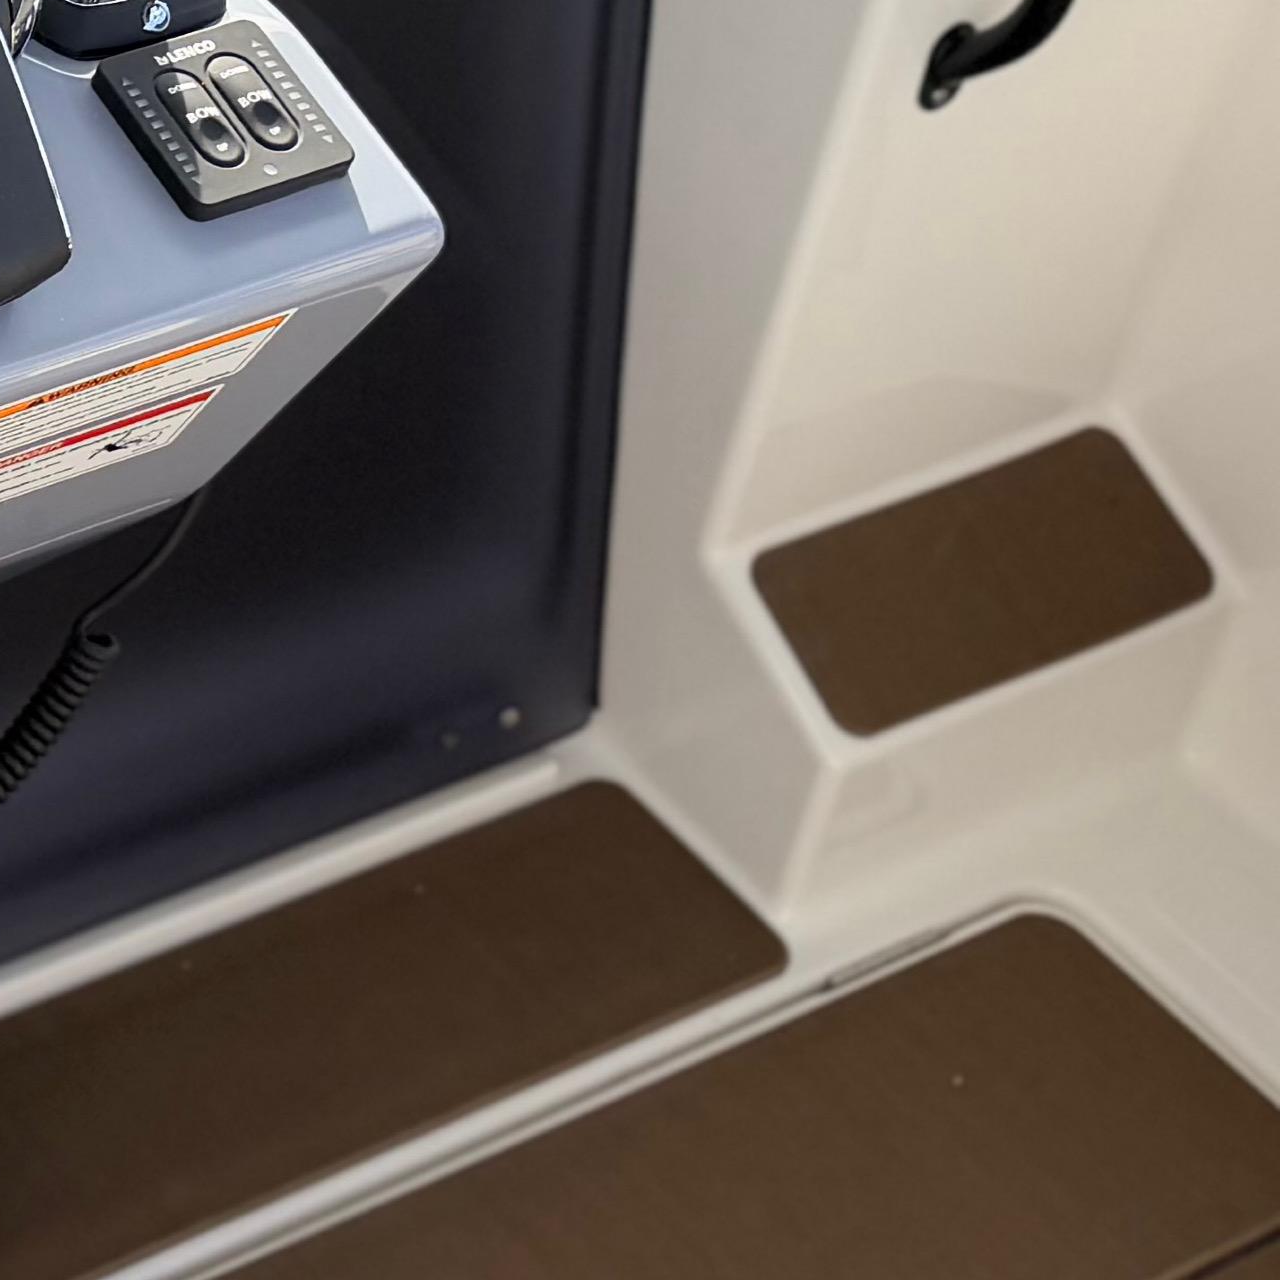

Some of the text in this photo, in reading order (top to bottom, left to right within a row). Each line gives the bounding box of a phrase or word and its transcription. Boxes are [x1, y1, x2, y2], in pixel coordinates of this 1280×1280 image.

[166, 40, 216, 63] LENCO
[236, 88, 274, 109] BOW
[184, 105, 222, 125] BOW
